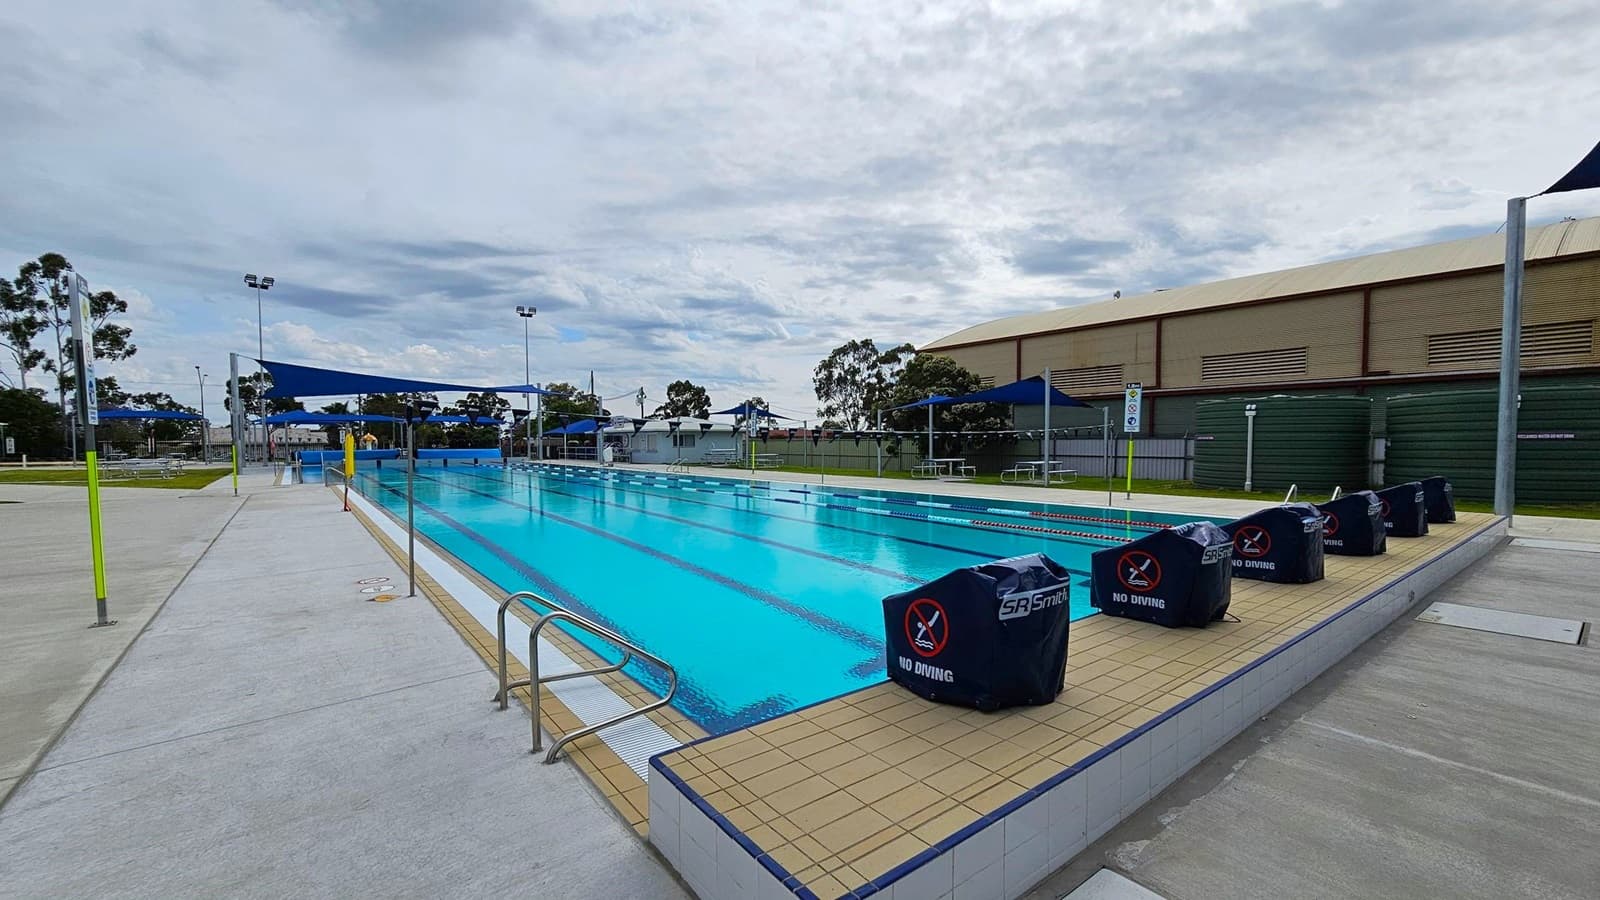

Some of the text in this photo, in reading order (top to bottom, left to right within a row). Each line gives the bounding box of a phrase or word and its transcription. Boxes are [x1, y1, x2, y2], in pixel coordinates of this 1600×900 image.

[1323, 539, 1344, 547] VING
[1245, 560, 1276, 570] DIVING
[1113, 592, 1165, 609] NO DIVING
[899, 655, 954, 683] NO DIVING
